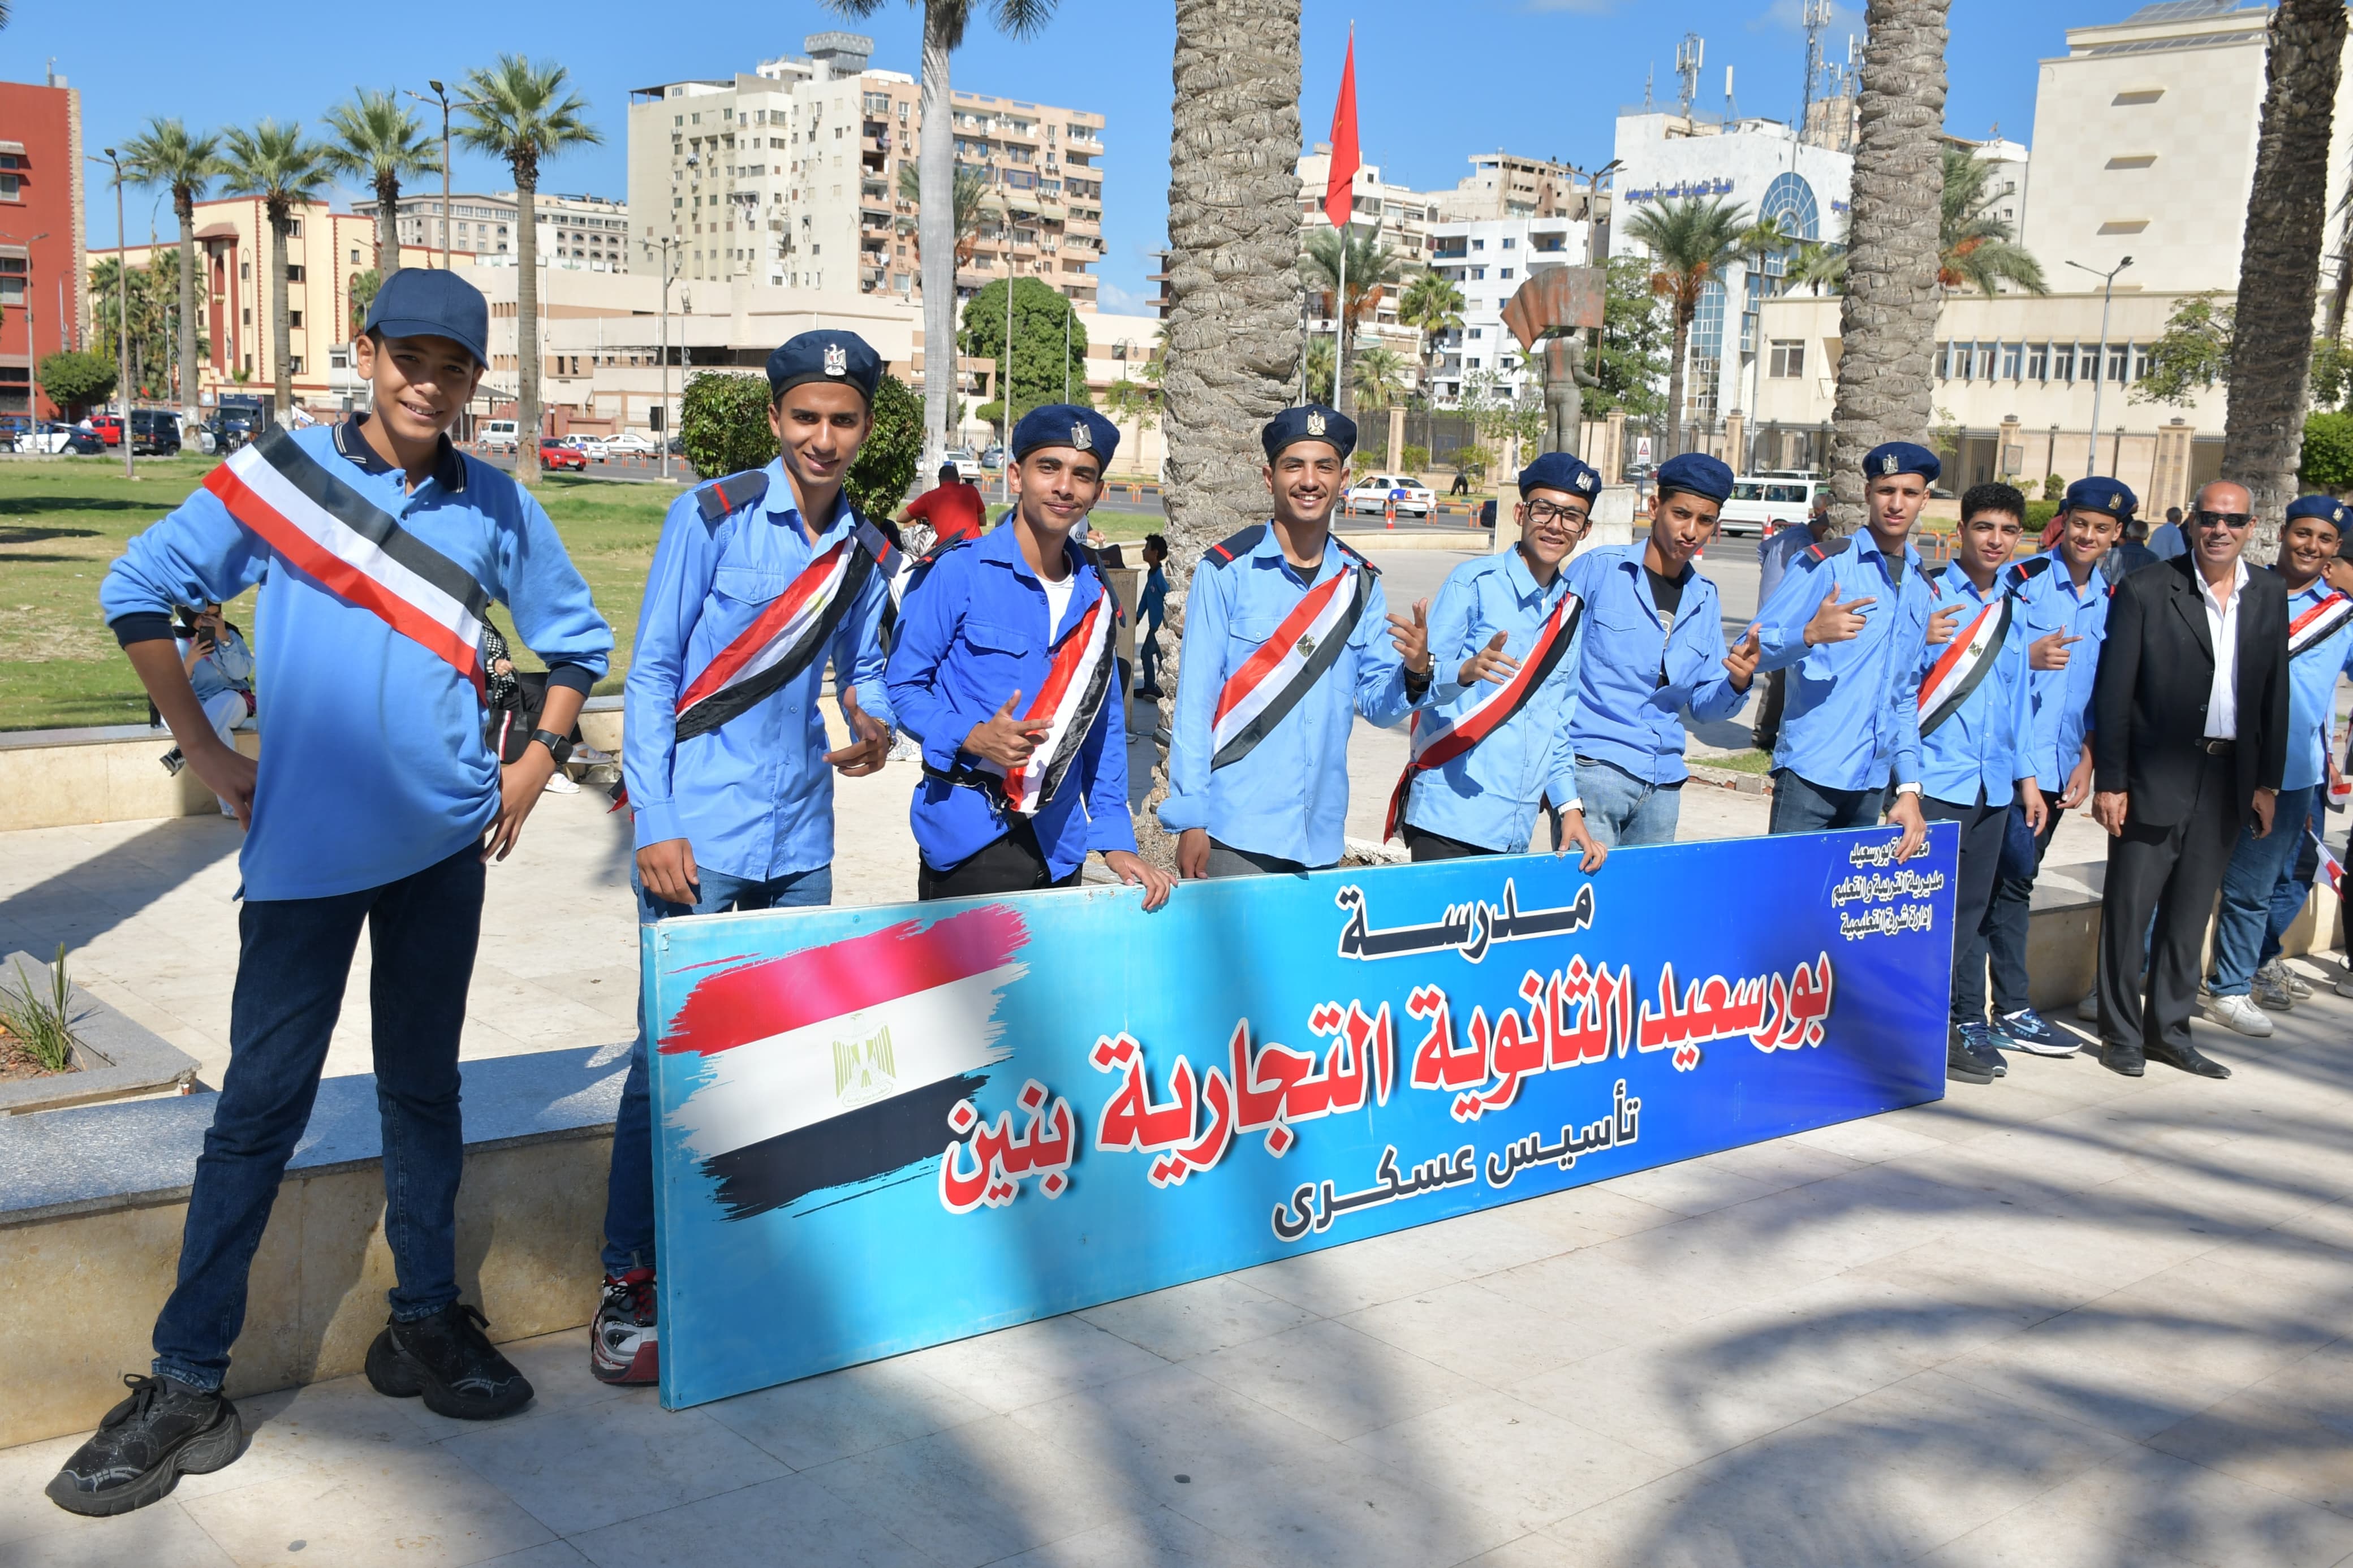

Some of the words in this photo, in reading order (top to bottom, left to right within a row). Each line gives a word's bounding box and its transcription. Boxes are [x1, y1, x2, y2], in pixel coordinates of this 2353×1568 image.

[1850, 843, 1890, 869] بورسعيد
[1872, 871, 1908, 901] التربية
[1907, 870, 1943, 898] مديرية
[1335, 878, 1594, 964] مدرسة
[1840, 909, 1885, 940] التعليمية
[1884, 904, 1909, 935] شرق
[1909, 904, 1932, 931] إدارة
[1406, 954, 1631, 1122] الثانوية
[1637, 951, 1832, 1072] بورسعيد
[1089, 999, 1392, 1189] التجارية
[1485, 1079, 1640, 1188] تأسيس
[938, 1078, 1075, 1214] بنين
[1272, 1146, 1475, 1242] عسكرى
